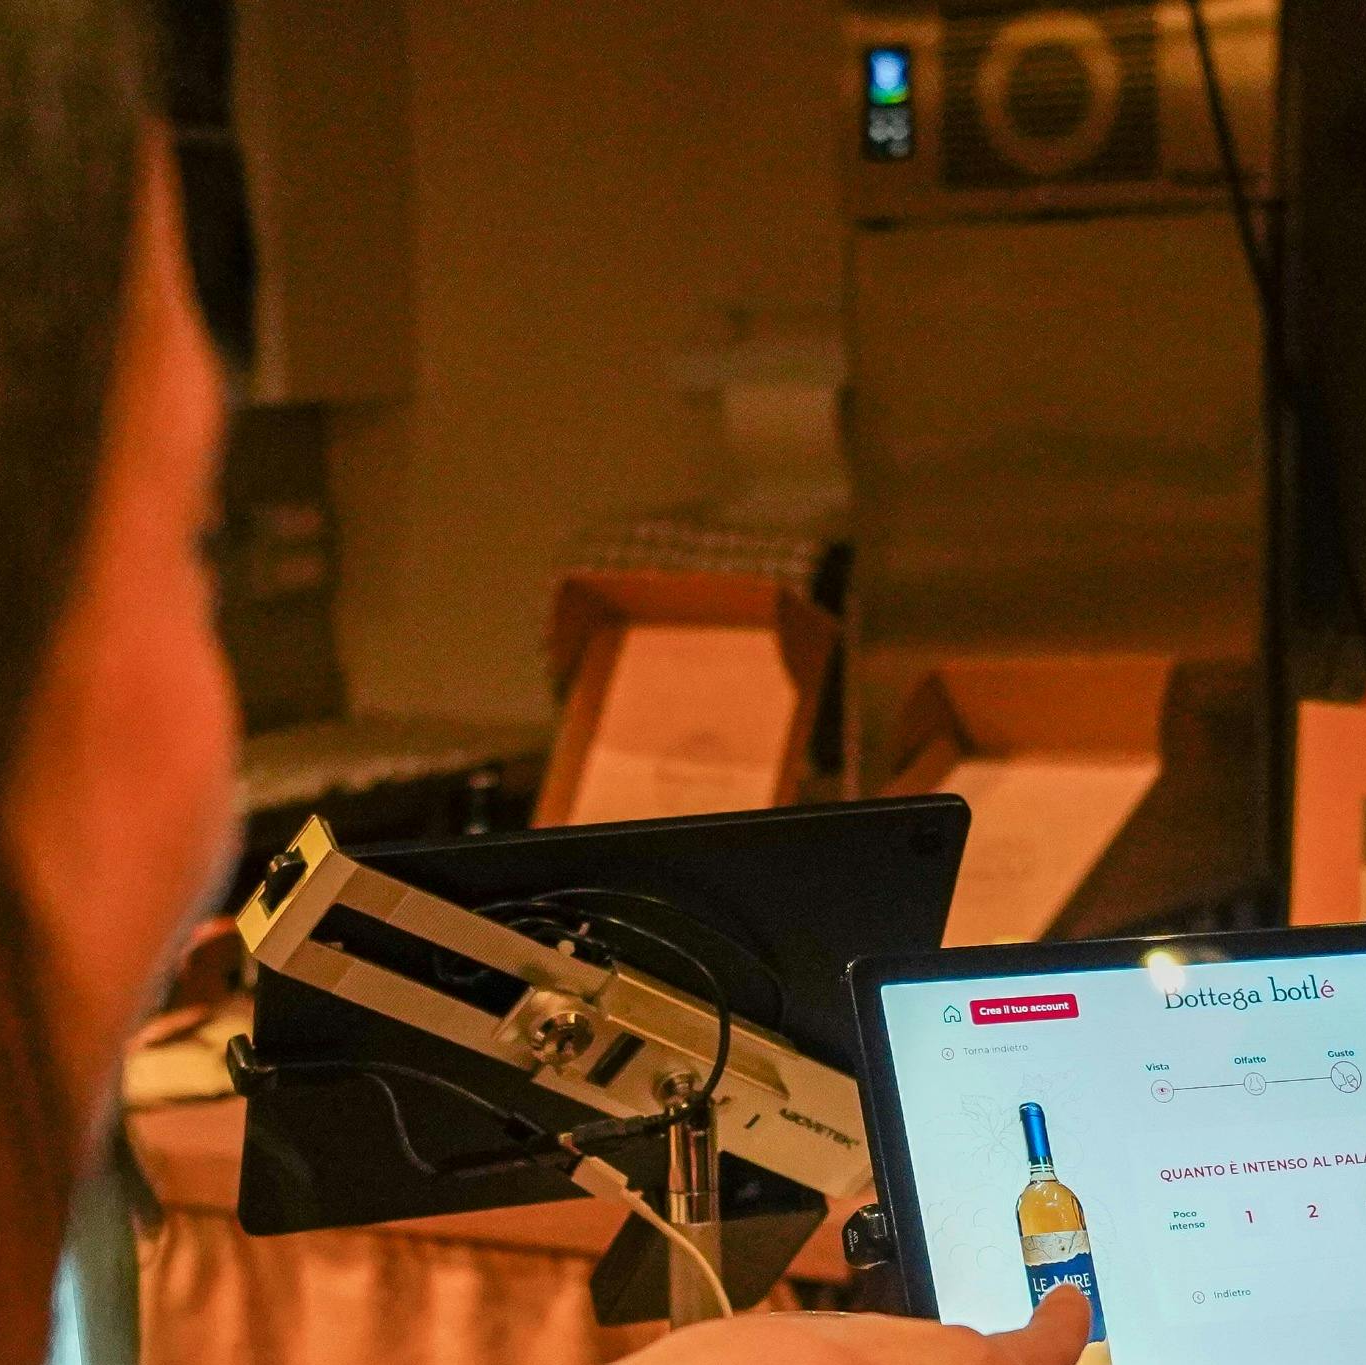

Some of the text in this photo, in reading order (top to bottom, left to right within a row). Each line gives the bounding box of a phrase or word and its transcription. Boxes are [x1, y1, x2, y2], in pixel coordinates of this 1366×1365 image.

[1164, 974, 1335, 1011] Bottega botlé
[978, 1001, 1070, 1016] Crea il tuo account
[962, 1043, 1029, 1056] Torna indietro
[1327, 1049, 1355, 1058] Gusto
[1234, 1055, 1267, 1065] Olfatto
[1145, 1062, 1170, 1072] Vista
[1160, 1164, 1225, 1183] QUANTO
[1230, 1161, 1239, 1175] È
[1243, 1157, 1308, 1174] INTENSO
[1312, 1155, 1332, 1169] AL
[1172, 1209, 1197, 1219] Poco
[1245, 1210, 1254, 1224] 1
[1306, 1204, 1319, 1218] 2
[1169, 1221, 1206, 1231] intenso
[1032, 1277, 1048, 1292] LE
[1213, 1287, 1252, 1299] Indietro
